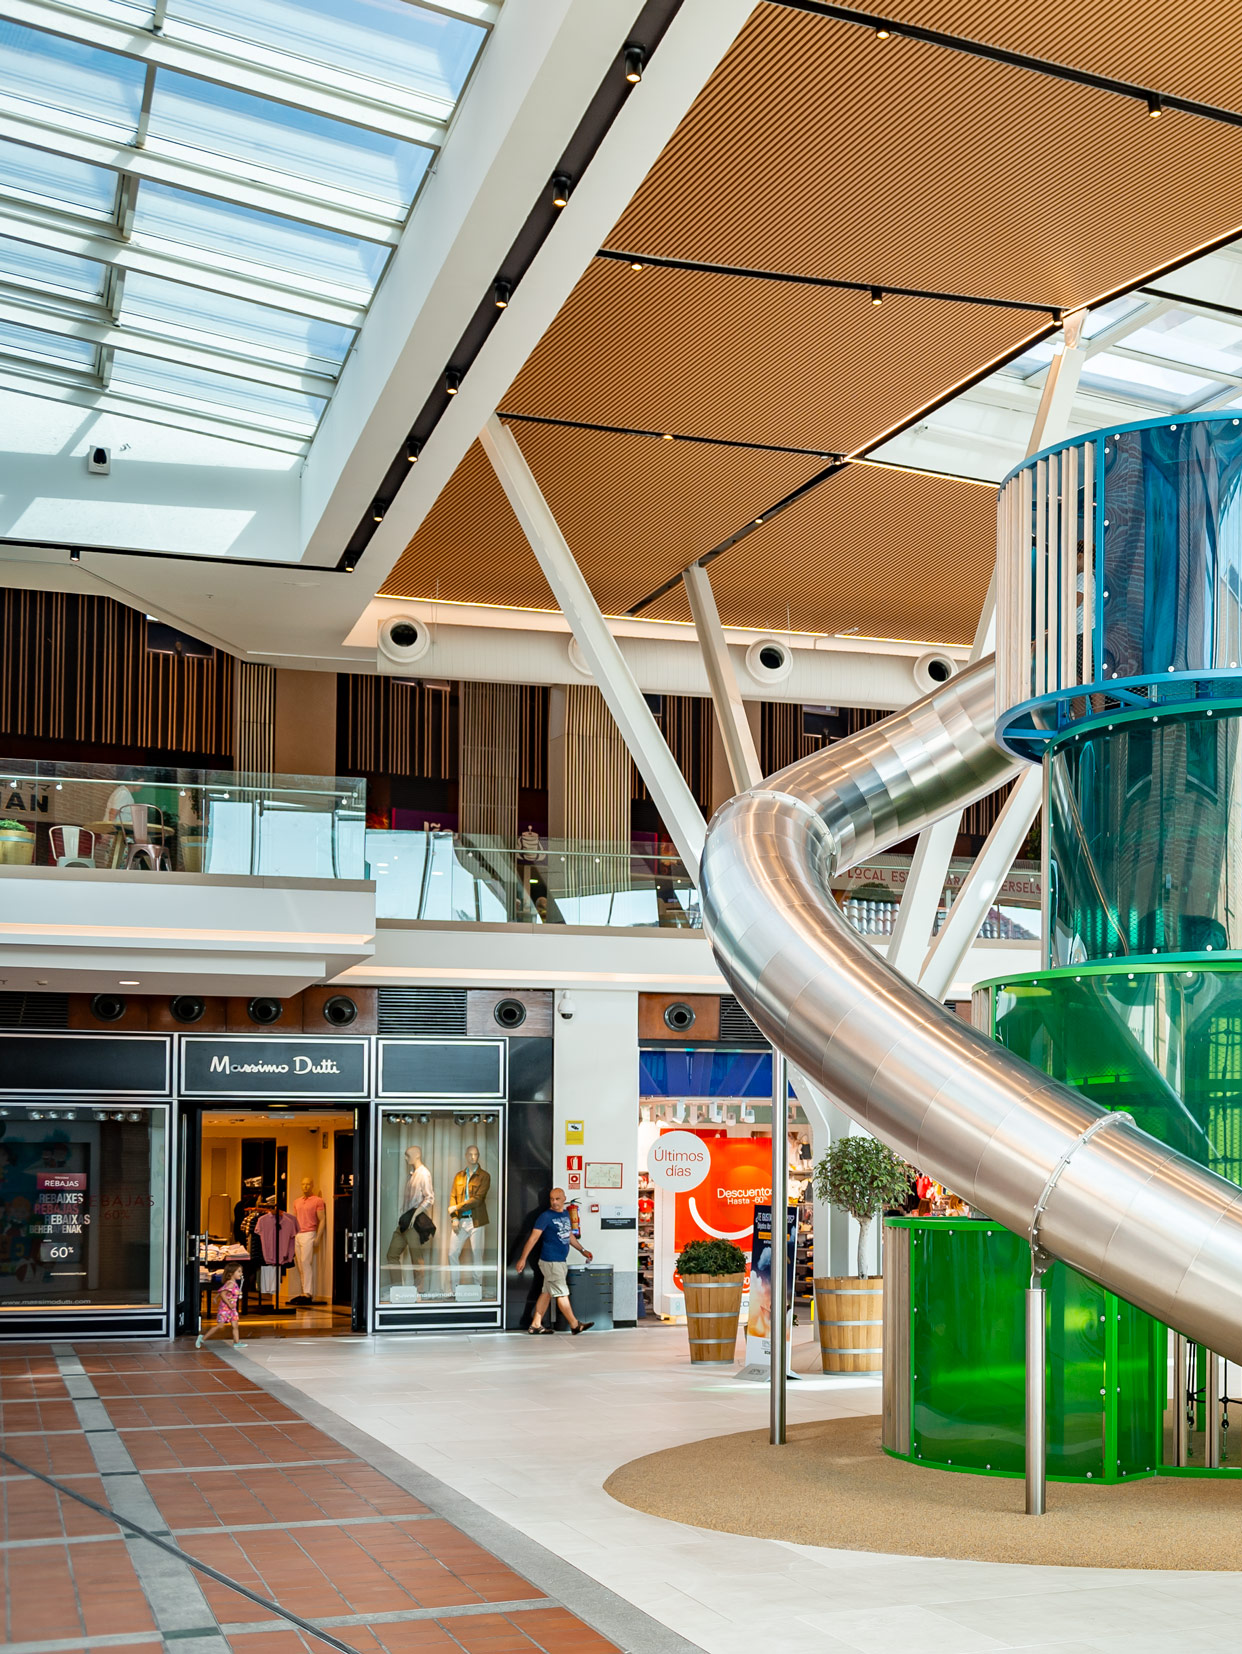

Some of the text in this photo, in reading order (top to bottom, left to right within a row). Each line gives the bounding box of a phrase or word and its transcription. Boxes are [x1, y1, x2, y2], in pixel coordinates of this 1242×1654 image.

[847, 868, 886, 881] LOCAL
[209, 1055, 341, 1075] Massimo Dutti
[653, 1146, 704, 1162] Últimos
[665, 1164, 692, 1177] días
[39, 1193, 84, 1204] REBAIXES
[727, 1197, 750, 1205] Hasta
[34, 1203, 79, 1214] REBAJAS
[45, 1214, 91, 1225] REBAIXAS
[50, 1246, 74, 1258] 60%
